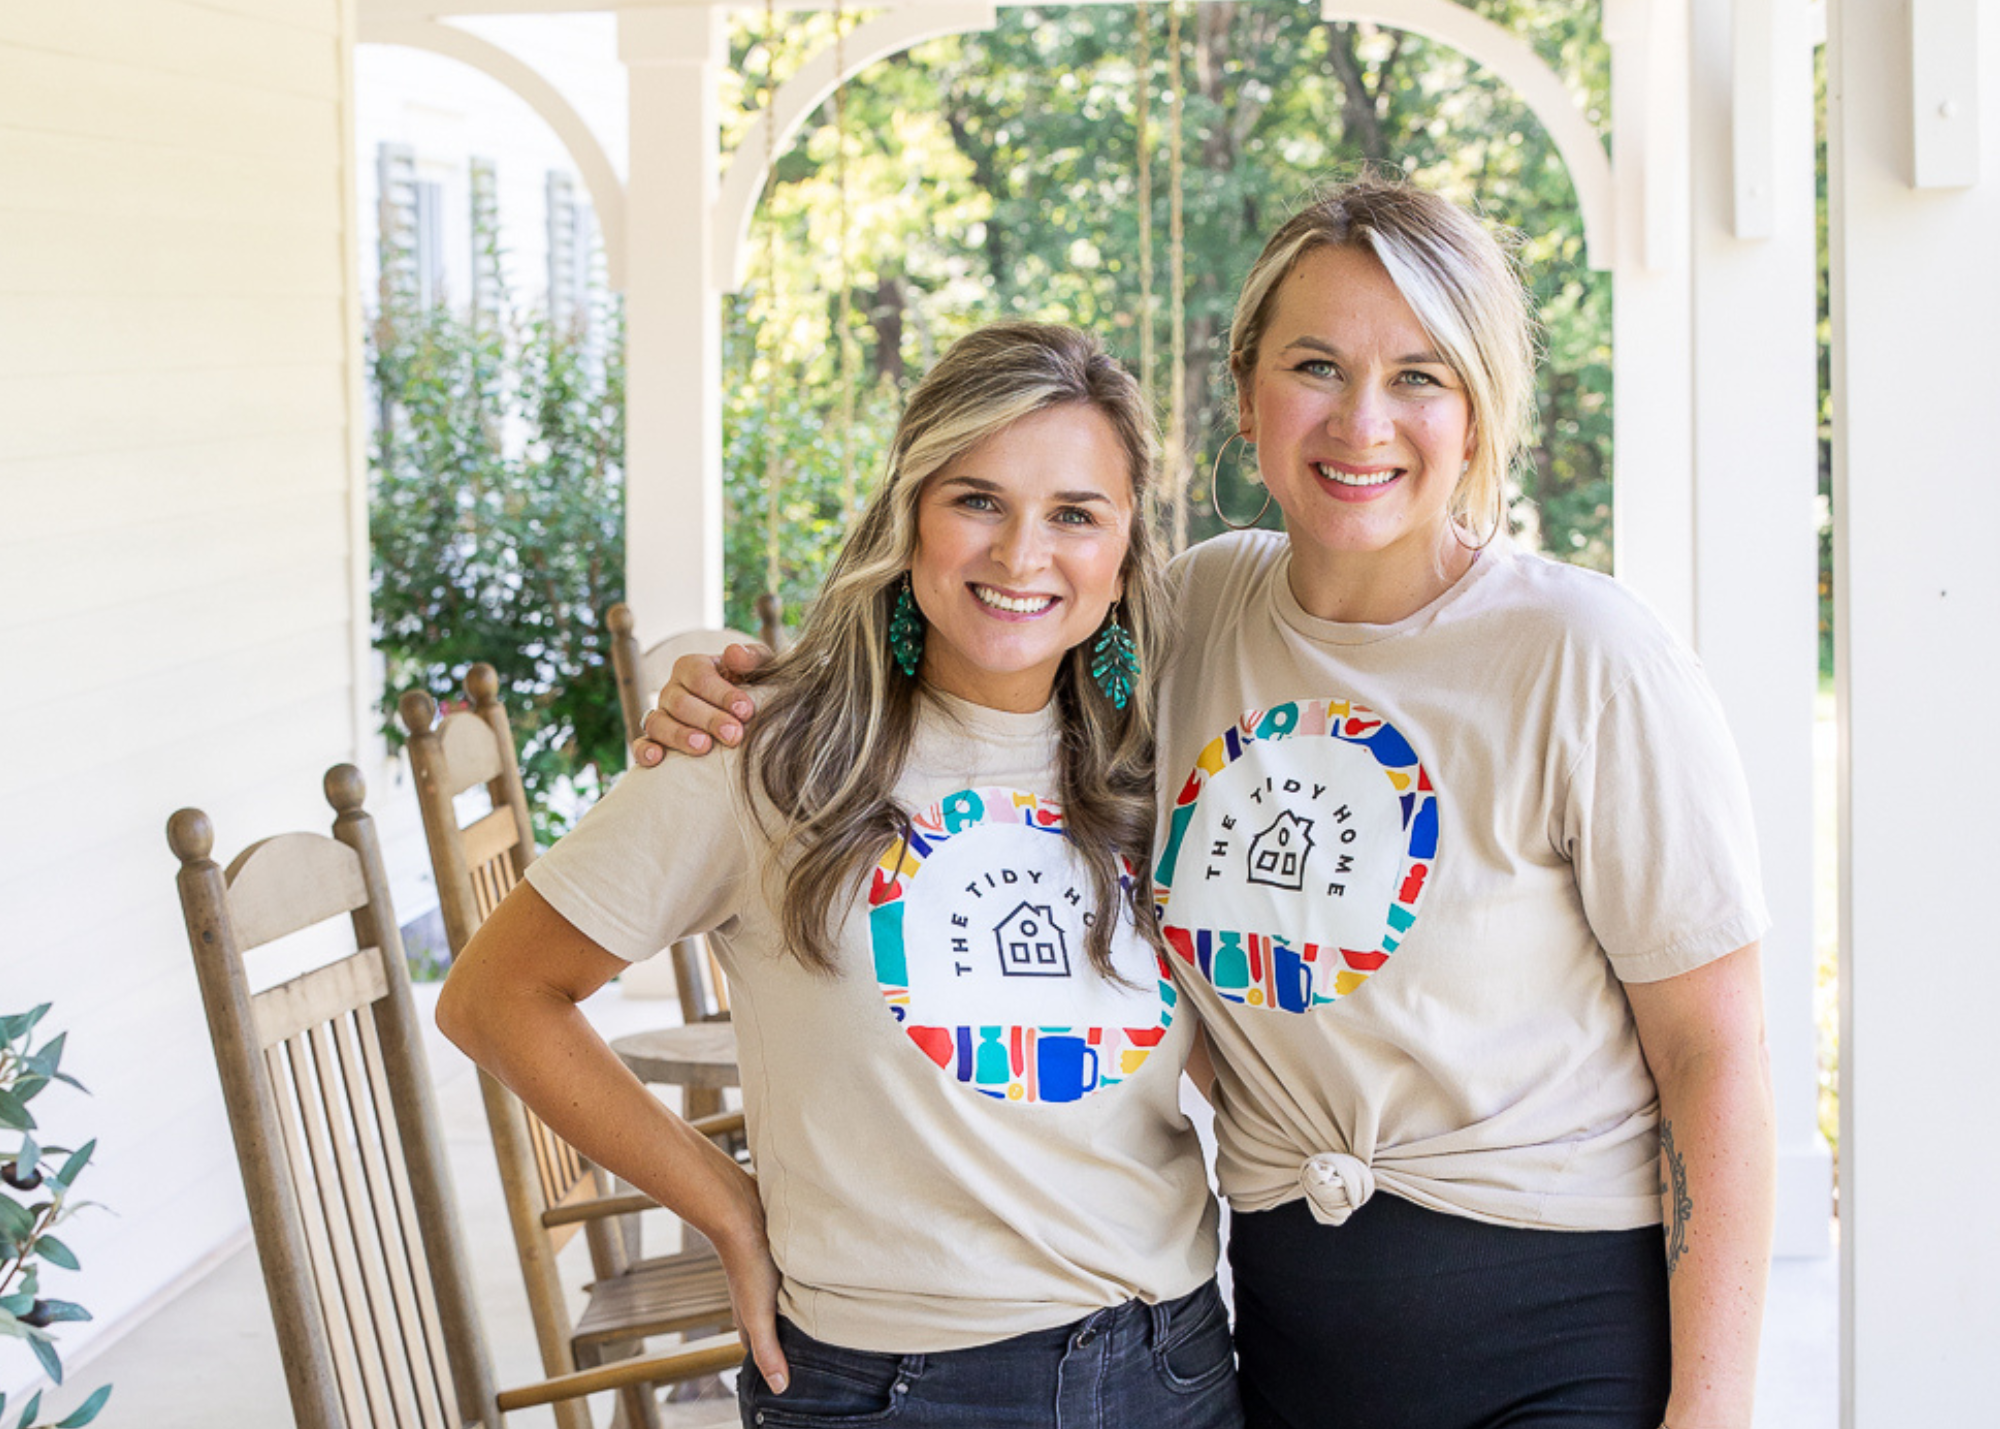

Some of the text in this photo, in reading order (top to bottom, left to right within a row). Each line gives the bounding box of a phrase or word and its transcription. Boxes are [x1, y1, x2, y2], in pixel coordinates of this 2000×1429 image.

[1205, 777, 1356, 897] THE TIDY HOME
[951, 869, 1097, 976] THE TIDY HO
